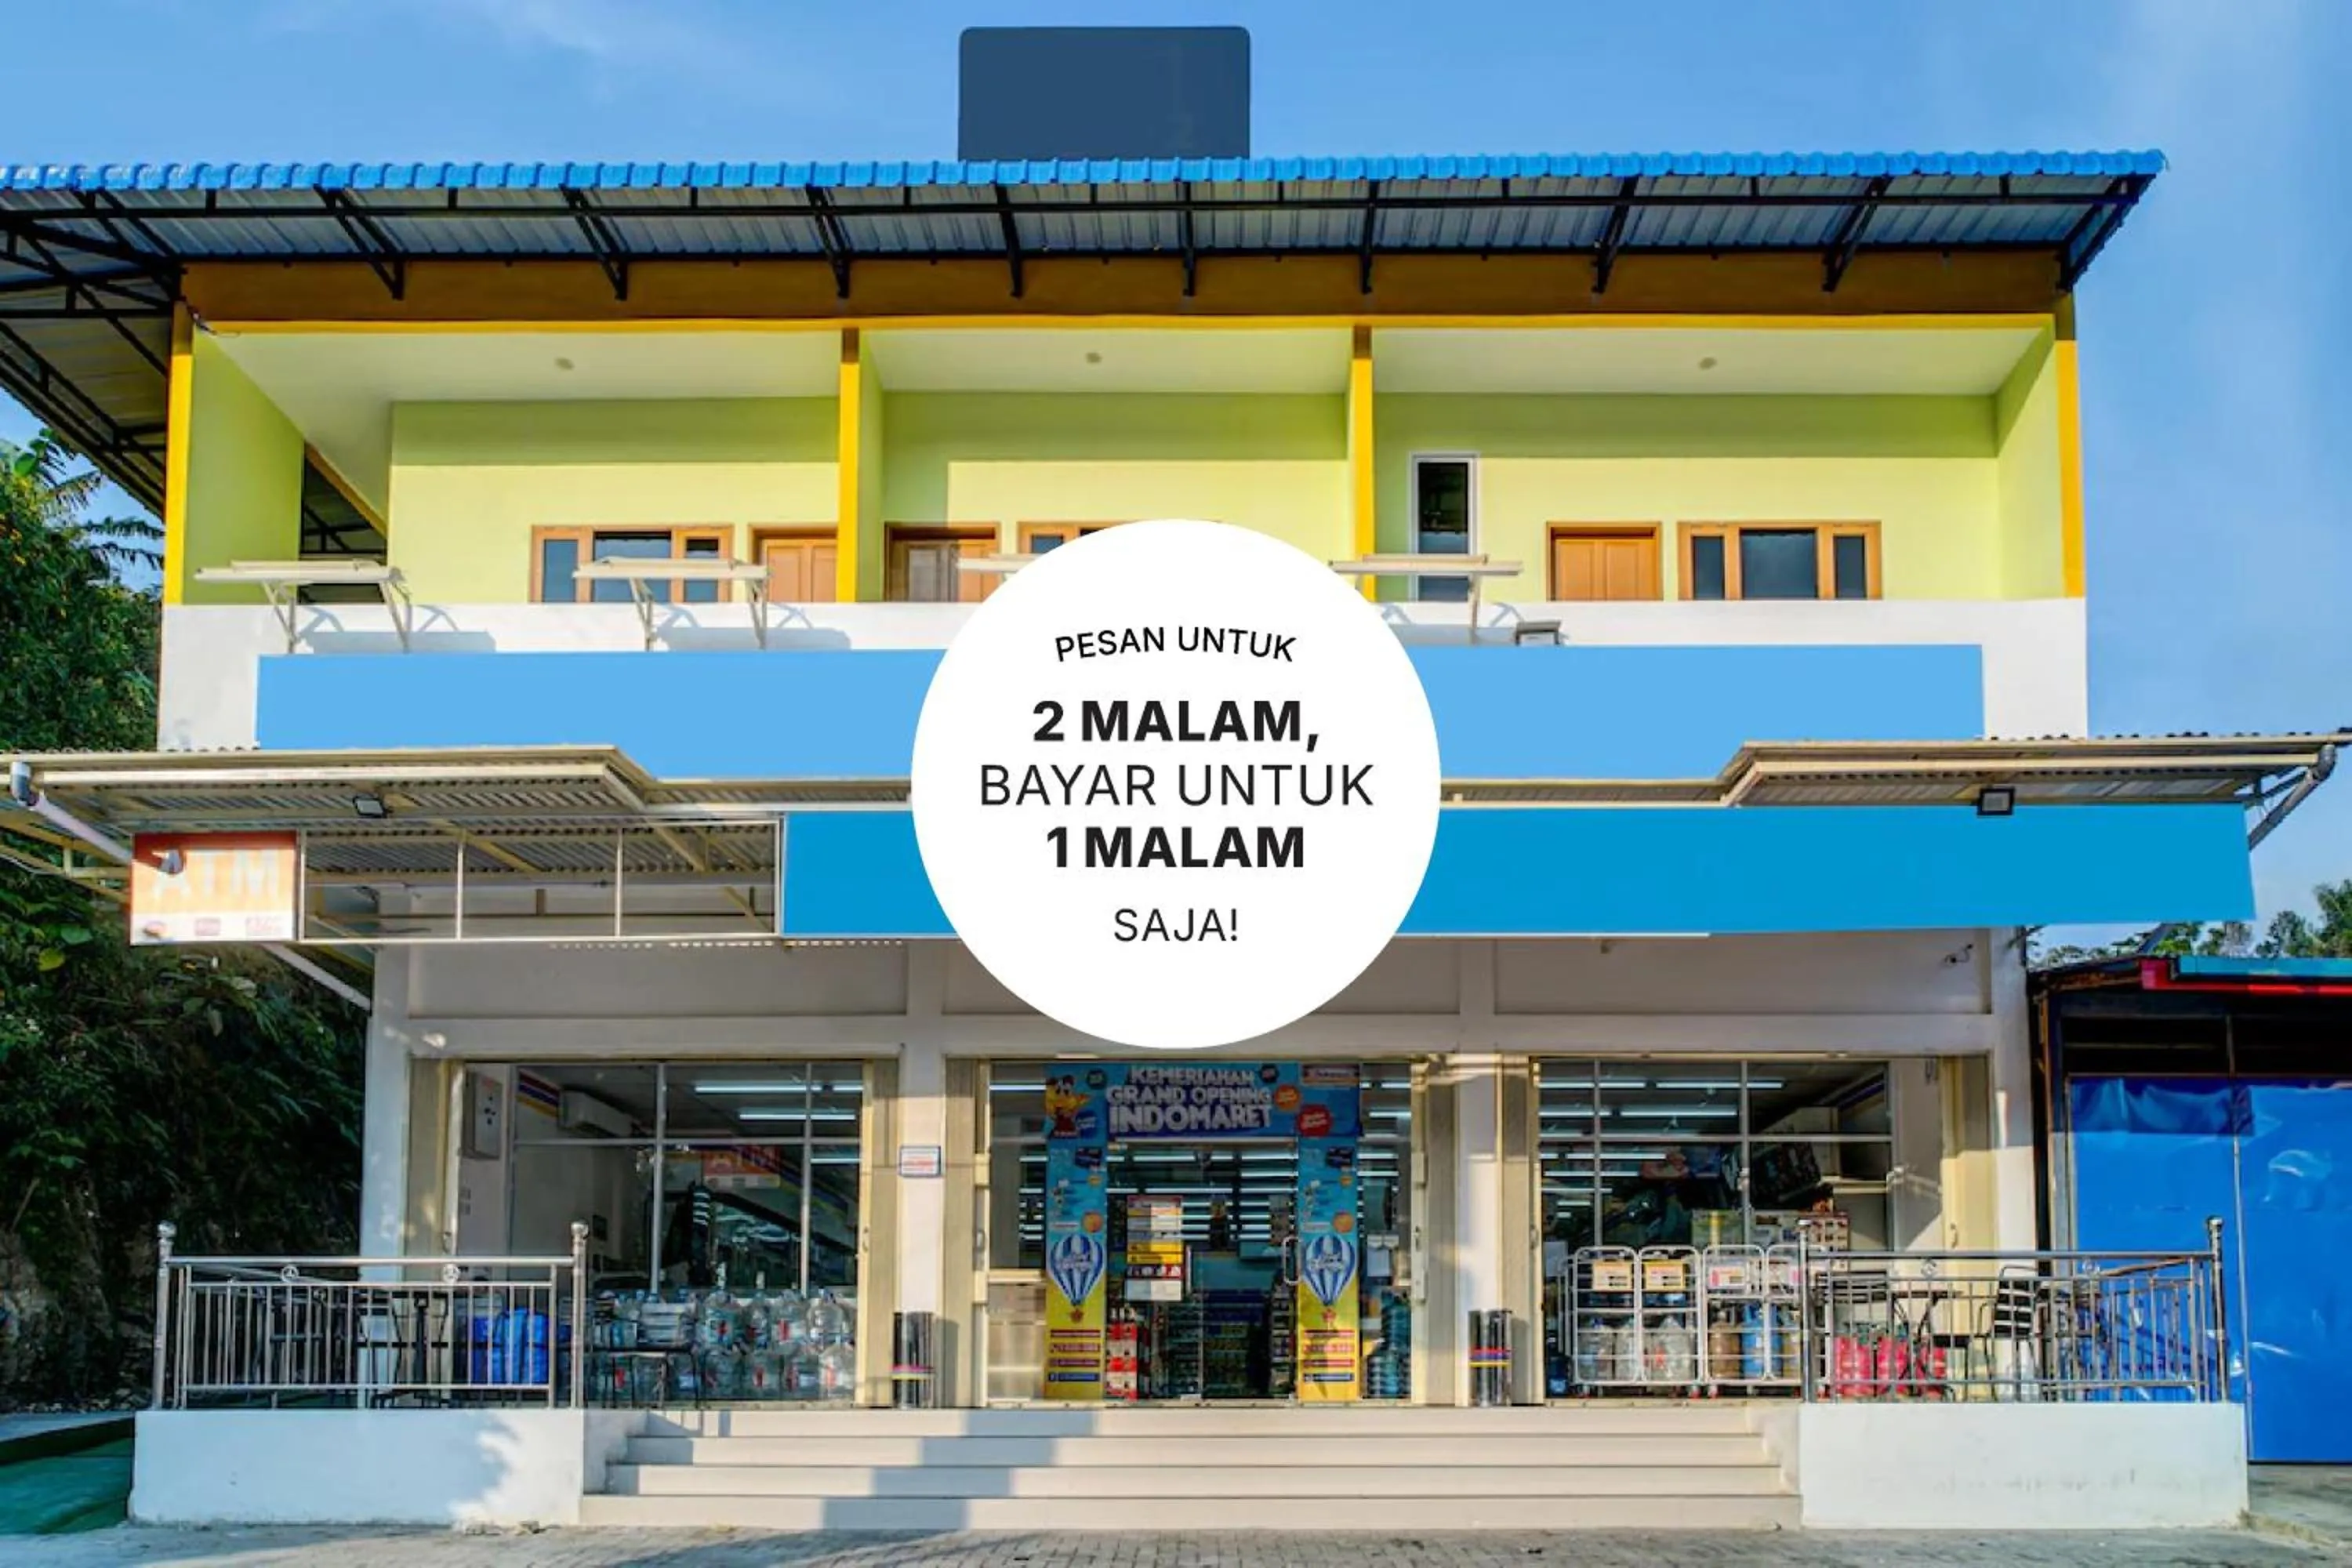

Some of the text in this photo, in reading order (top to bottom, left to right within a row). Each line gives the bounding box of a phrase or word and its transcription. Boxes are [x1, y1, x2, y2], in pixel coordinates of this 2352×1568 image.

[151, 849, 280, 899] ATM
[1131, 1065, 1254, 1087] KEMERIAHAN
[1105, 1084, 1187, 1105] GRAND
[1190, 1085, 1273, 1106] OPENING
[1108, 1103, 1273, 1134] INDOMARET
